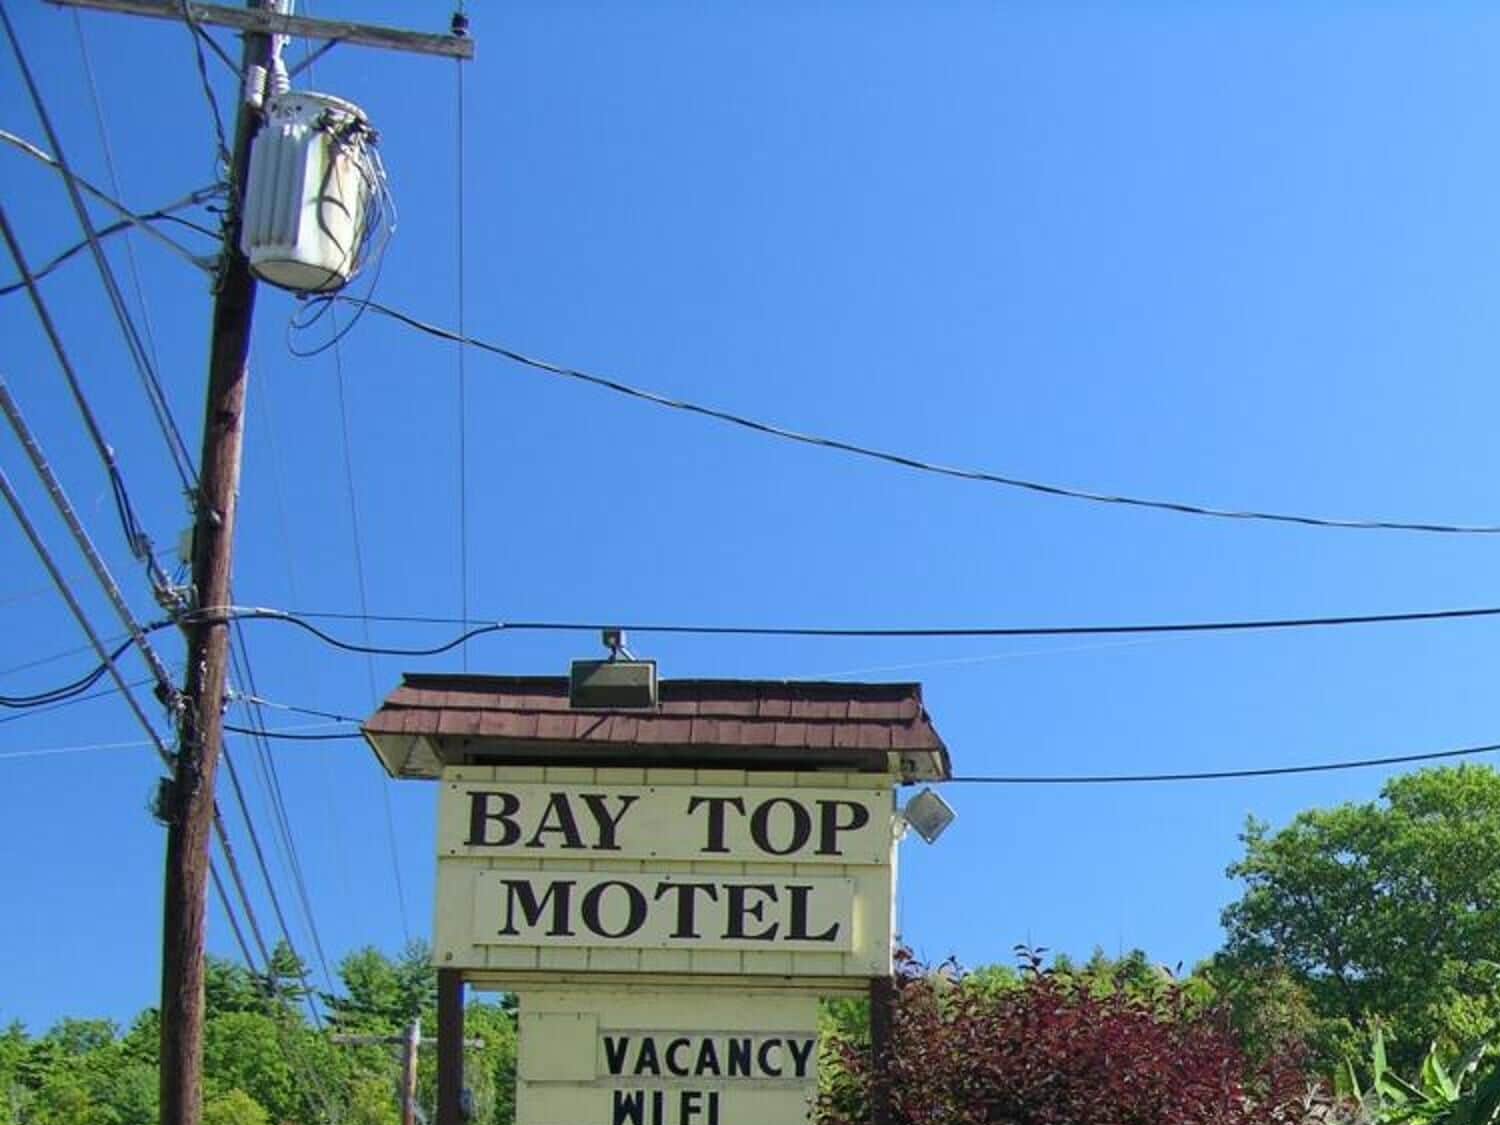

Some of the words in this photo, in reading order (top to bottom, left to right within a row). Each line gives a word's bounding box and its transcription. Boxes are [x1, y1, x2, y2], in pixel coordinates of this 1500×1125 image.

[463, 791, 640, 851] BAY
[687, 797, 870, 856] TOP
[497, 879, 841, 942] MOTEL
[603, 1036, 816, 1077] VACANCY
